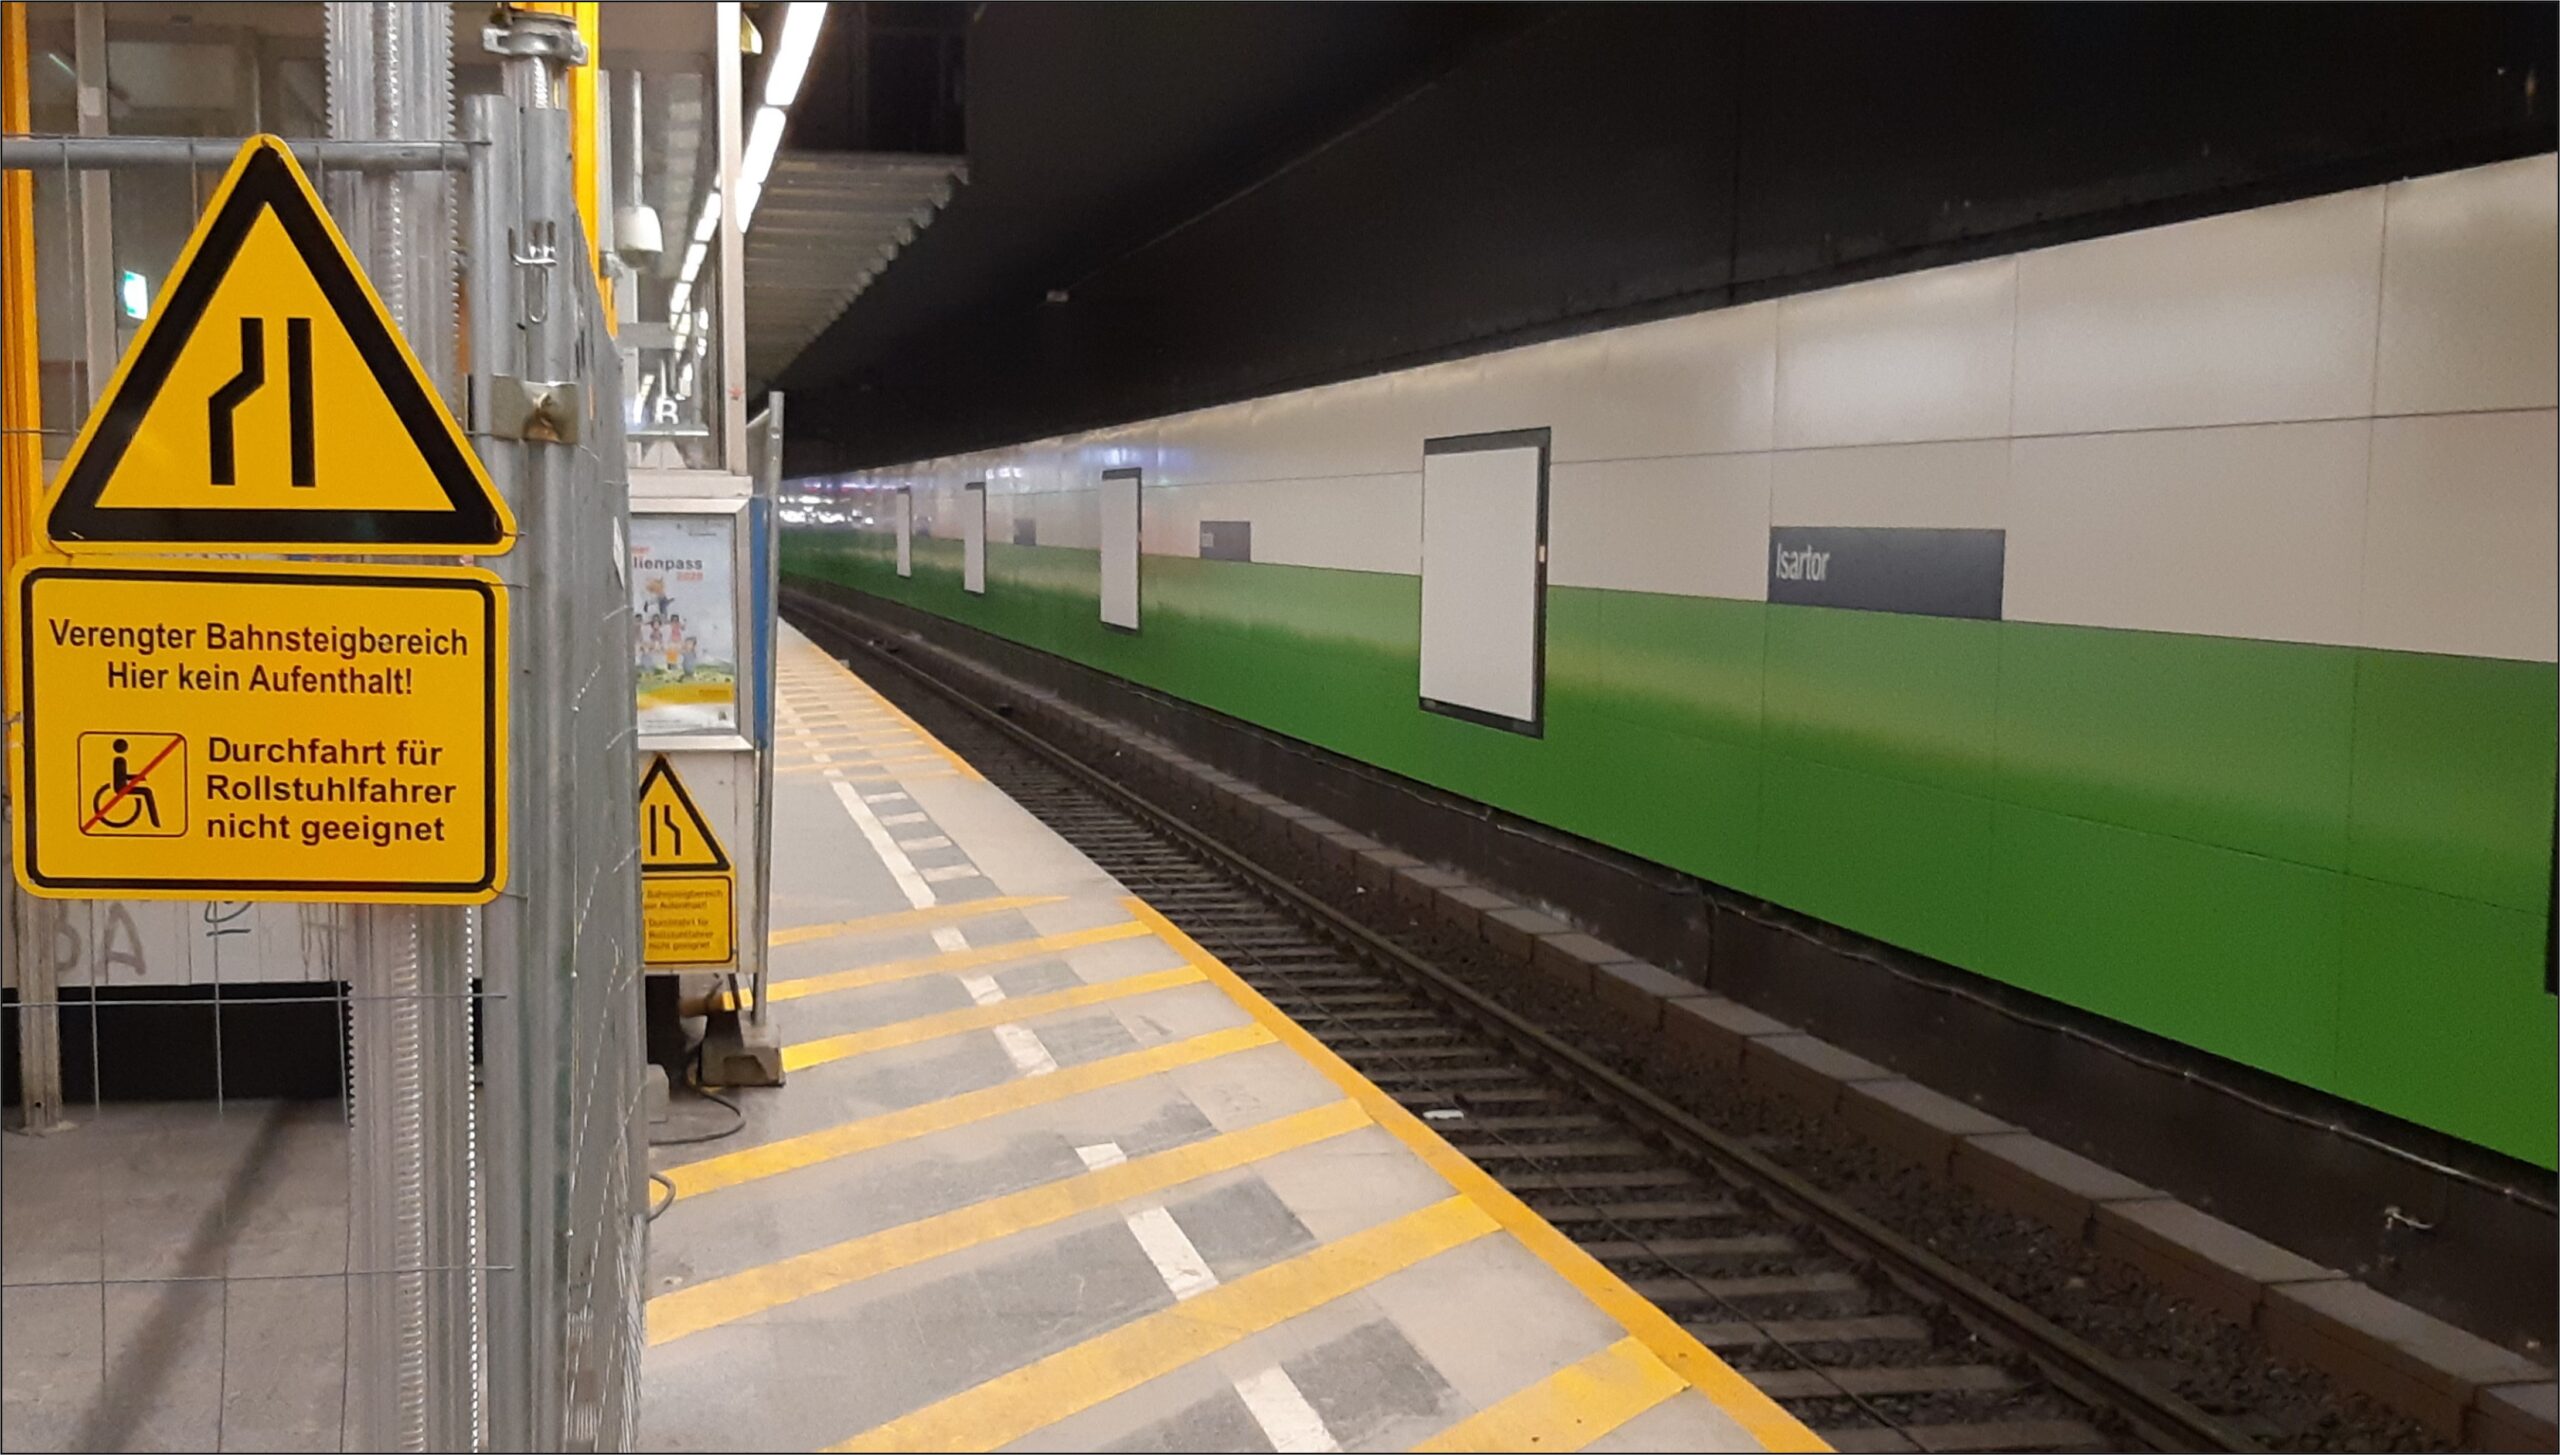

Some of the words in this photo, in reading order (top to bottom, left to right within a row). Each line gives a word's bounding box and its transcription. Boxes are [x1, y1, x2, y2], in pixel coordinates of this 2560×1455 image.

[633, 556, 703, 571] lienpass
[1775, 543, 1831, 581] Isartor
[49, 618, 197, 655] Verengter
[206, 622, 469, 659] Bahnsteigbereich
[107, 661, 169, 690] Hier
[178, 663, 239, 691] kein
[248, 665, 412, 695] Aufenthalt!
[208, 736, 386, 765] Durchfahrt
[396, 739, 443, 766] für
[206, 774, 457, 804] Rollstuhlfahrer
[207, 813, 291, 839] nicht
[301, 815, 445, 847] geeignet
